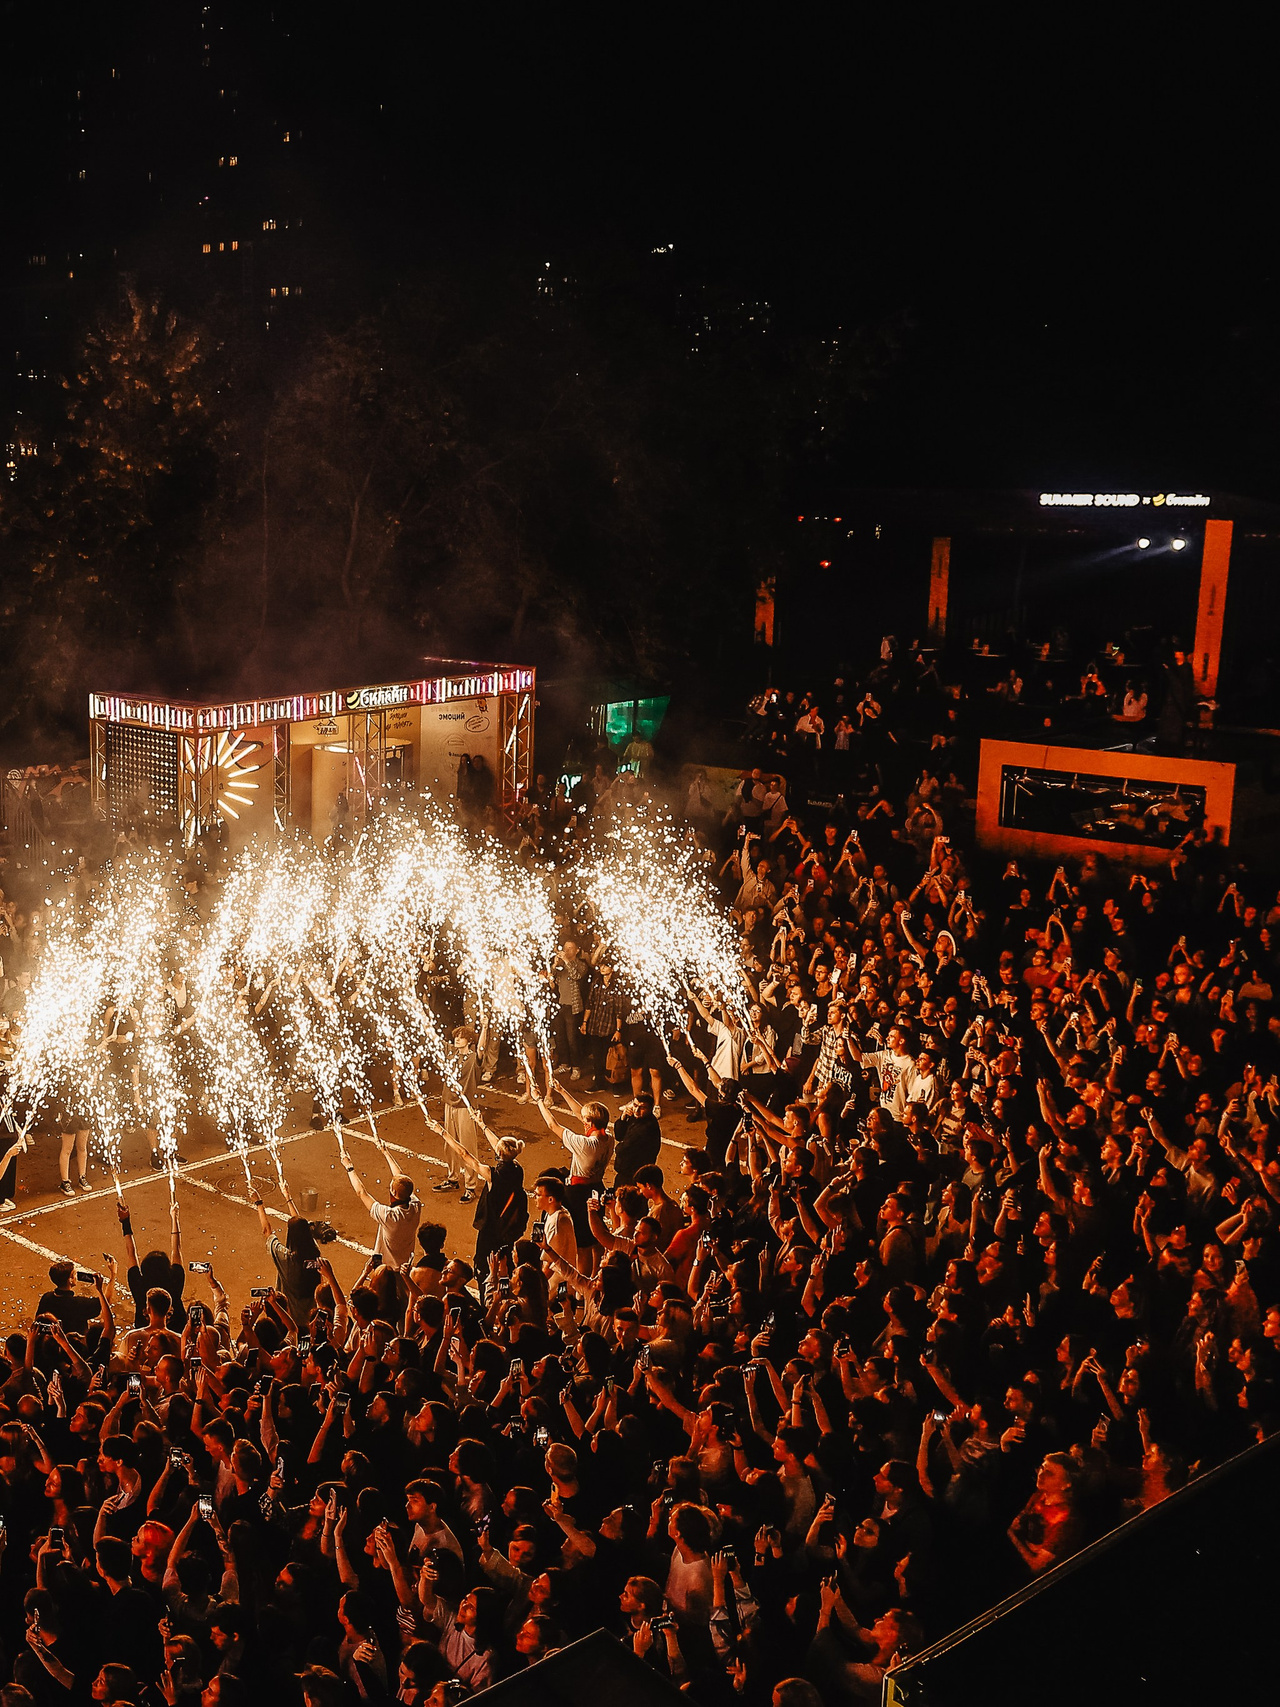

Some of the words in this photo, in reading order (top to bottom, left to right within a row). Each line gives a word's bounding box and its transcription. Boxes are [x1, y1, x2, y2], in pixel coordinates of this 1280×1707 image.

[1094, 493, 1140, 507] SOUND
[360, 687, 408, 708] билайн
[438, 711, 465, 721] ЭМОЦИЙ
